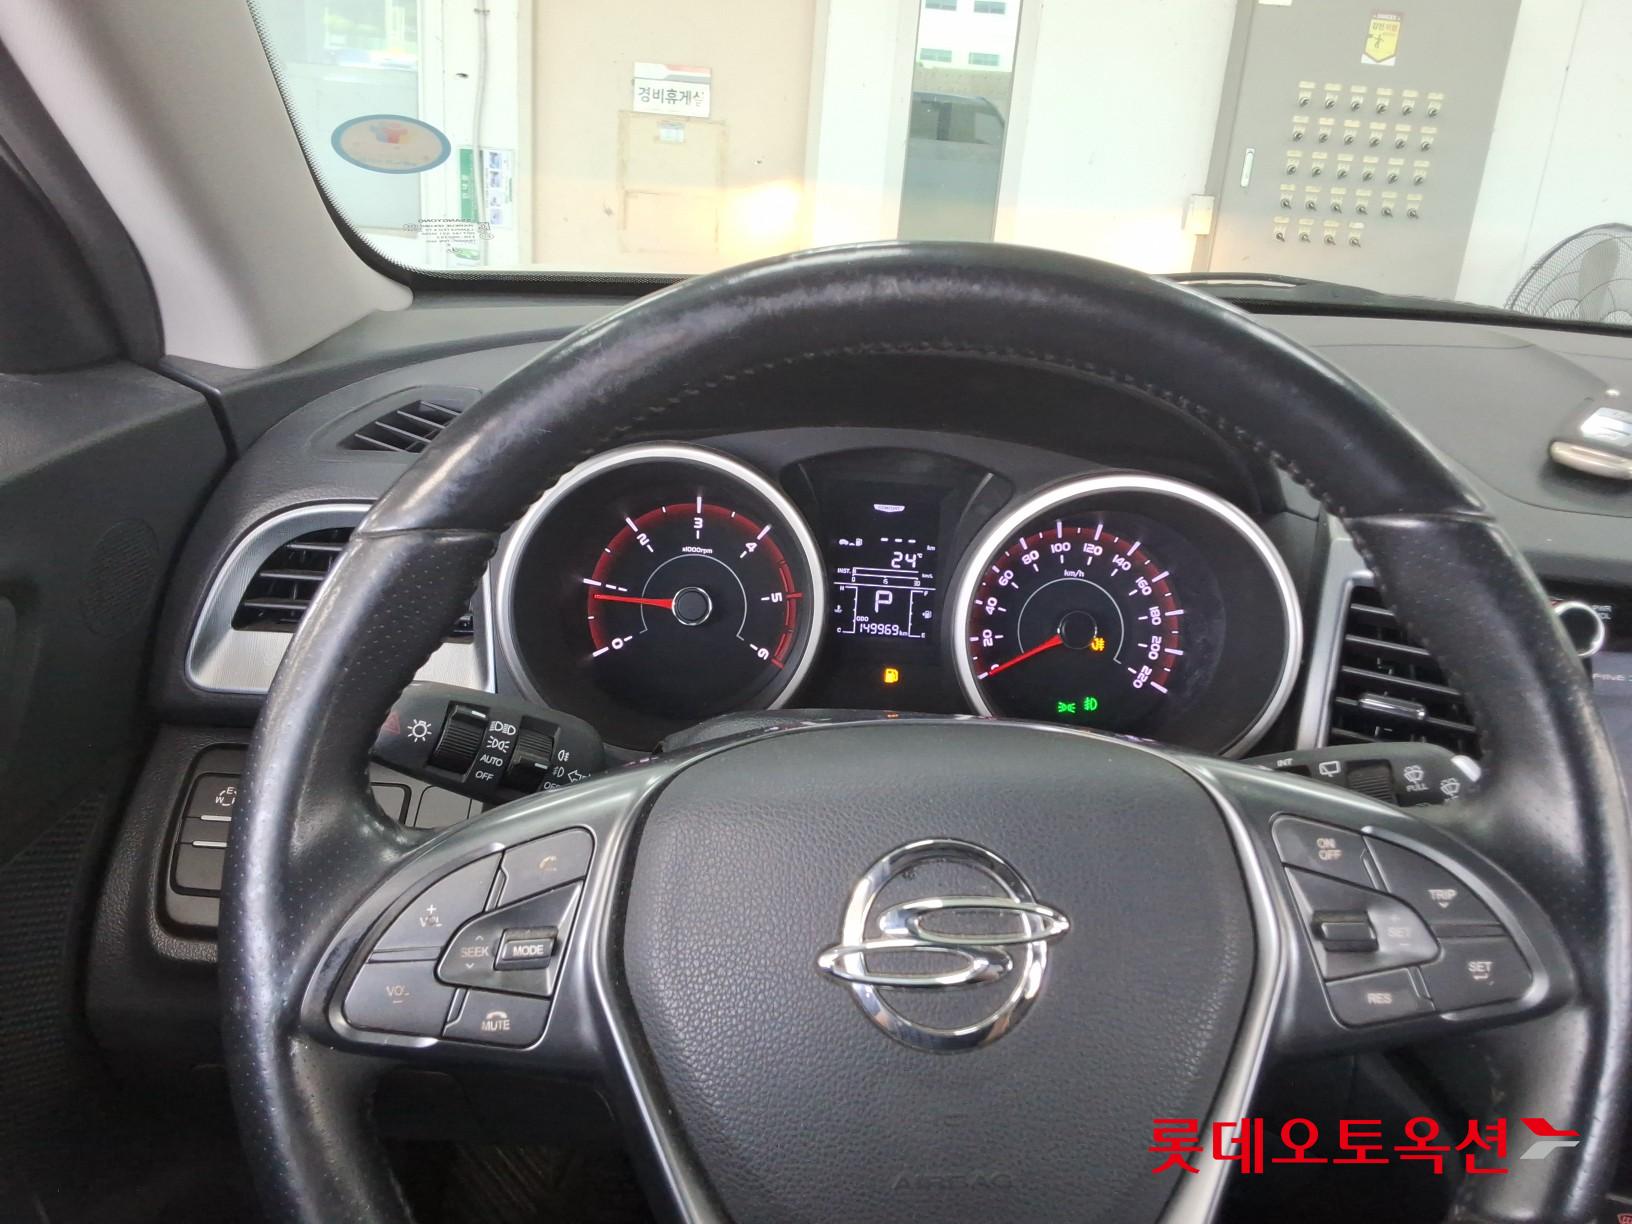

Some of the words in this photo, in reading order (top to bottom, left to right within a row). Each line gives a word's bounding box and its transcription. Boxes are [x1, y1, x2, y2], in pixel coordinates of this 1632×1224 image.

[693, 517, 704, 529] 3
[636, 533, 650, 547] 2
[744, 541, 758, 554] 4
[1050, 542, 1071, 554] 100
[1083, 543, 1103, 556] 120
[1022, 550, 1040, 566] 80
[1111, 554, 1132, 572] 140
[999, 570, 1014, 587] 60
[1064, 569, 1085, 578] km/h
[1135, 576, 1153, 596] 160
[771, 592, 782, 603] 5
[875, 590, 893, 613] P
[985, 597, 998, 616] 40
[1149, 606, 1162, 626] 180
[611, 637, 624, 650] 0
[982, 629, 993, 647] 20
[757, 647, 769, 660] 6
[1148, 635, 1162, 660] 200
[1132, 665, 1152, 689] 220
[479, 753, 503, 767] AUTO
[1277, 758, 1293, 767] INT
[475, 771, 494, 781] OFF
[1316, 838, 1335, 848] ON
[1318, 849, 1342, 860] OFF
[1428, 889, 1457, 900] TRIP
[460, 946, 489, 958] SEEK
[512, 944, 544, 956] MODE
[1468, 961, 1493, 973] SET
[1367, 993, 1392, 1005] RES
[481, 1019, 511, 1031] MUTE
